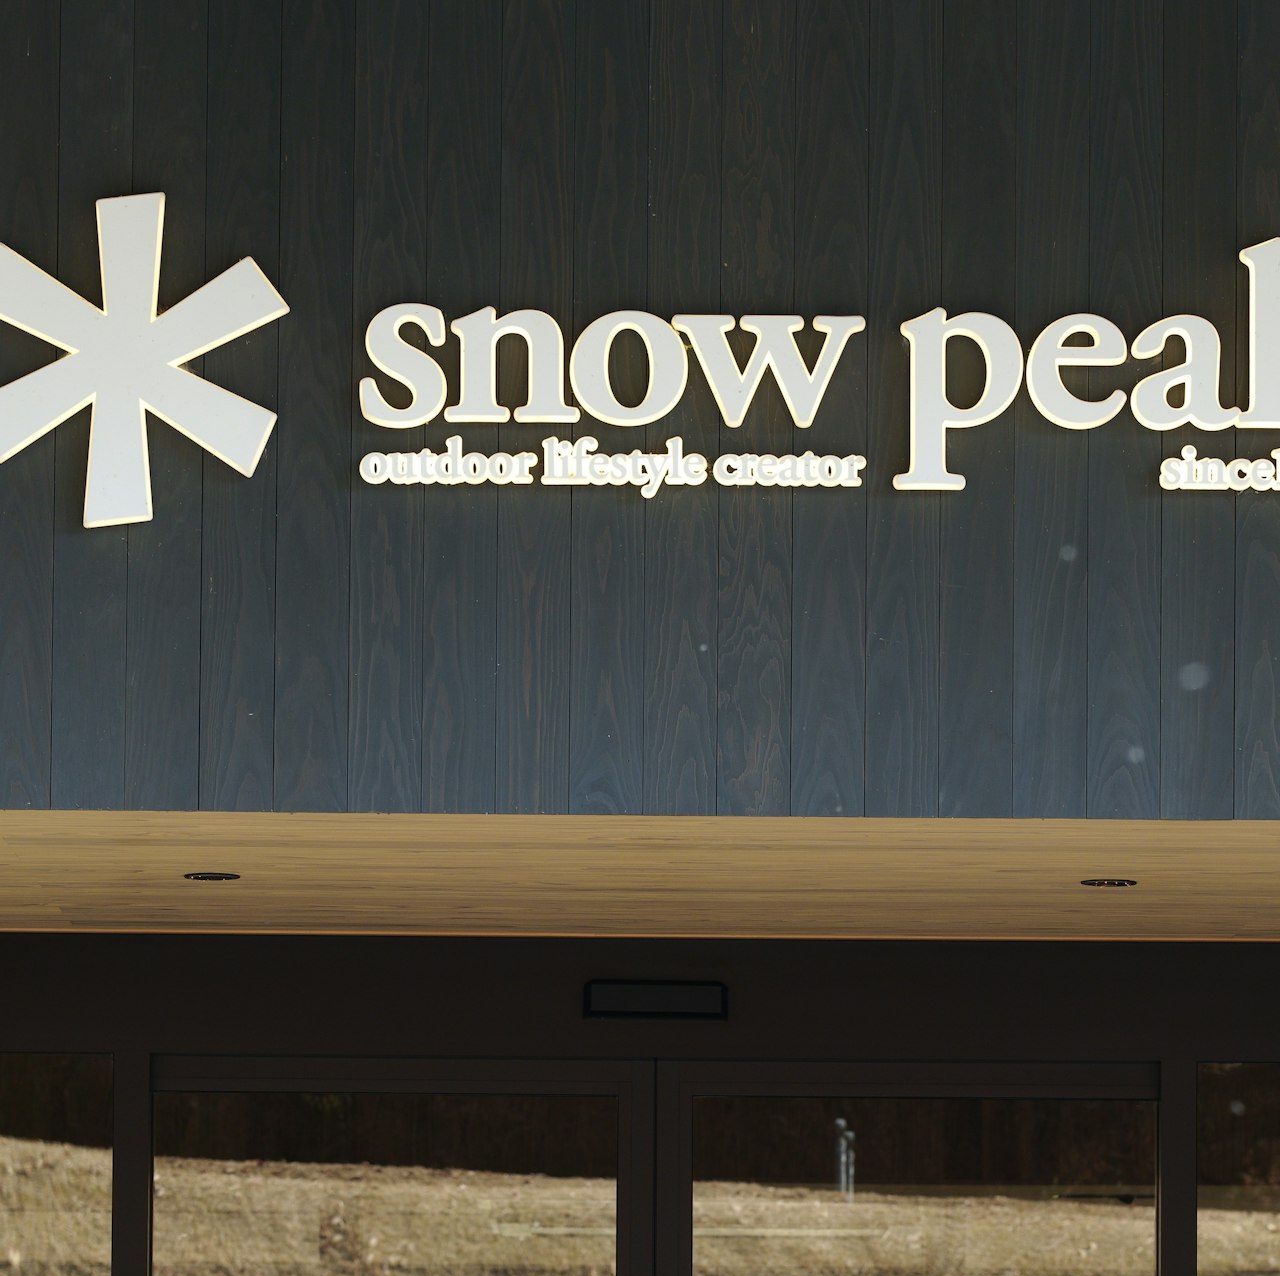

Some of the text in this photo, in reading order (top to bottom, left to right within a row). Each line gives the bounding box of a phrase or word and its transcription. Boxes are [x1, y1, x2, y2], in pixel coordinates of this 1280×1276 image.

[359, 302, 866, 431] snow
[359, 436, 867, 499] outdoor lifestyle creator
